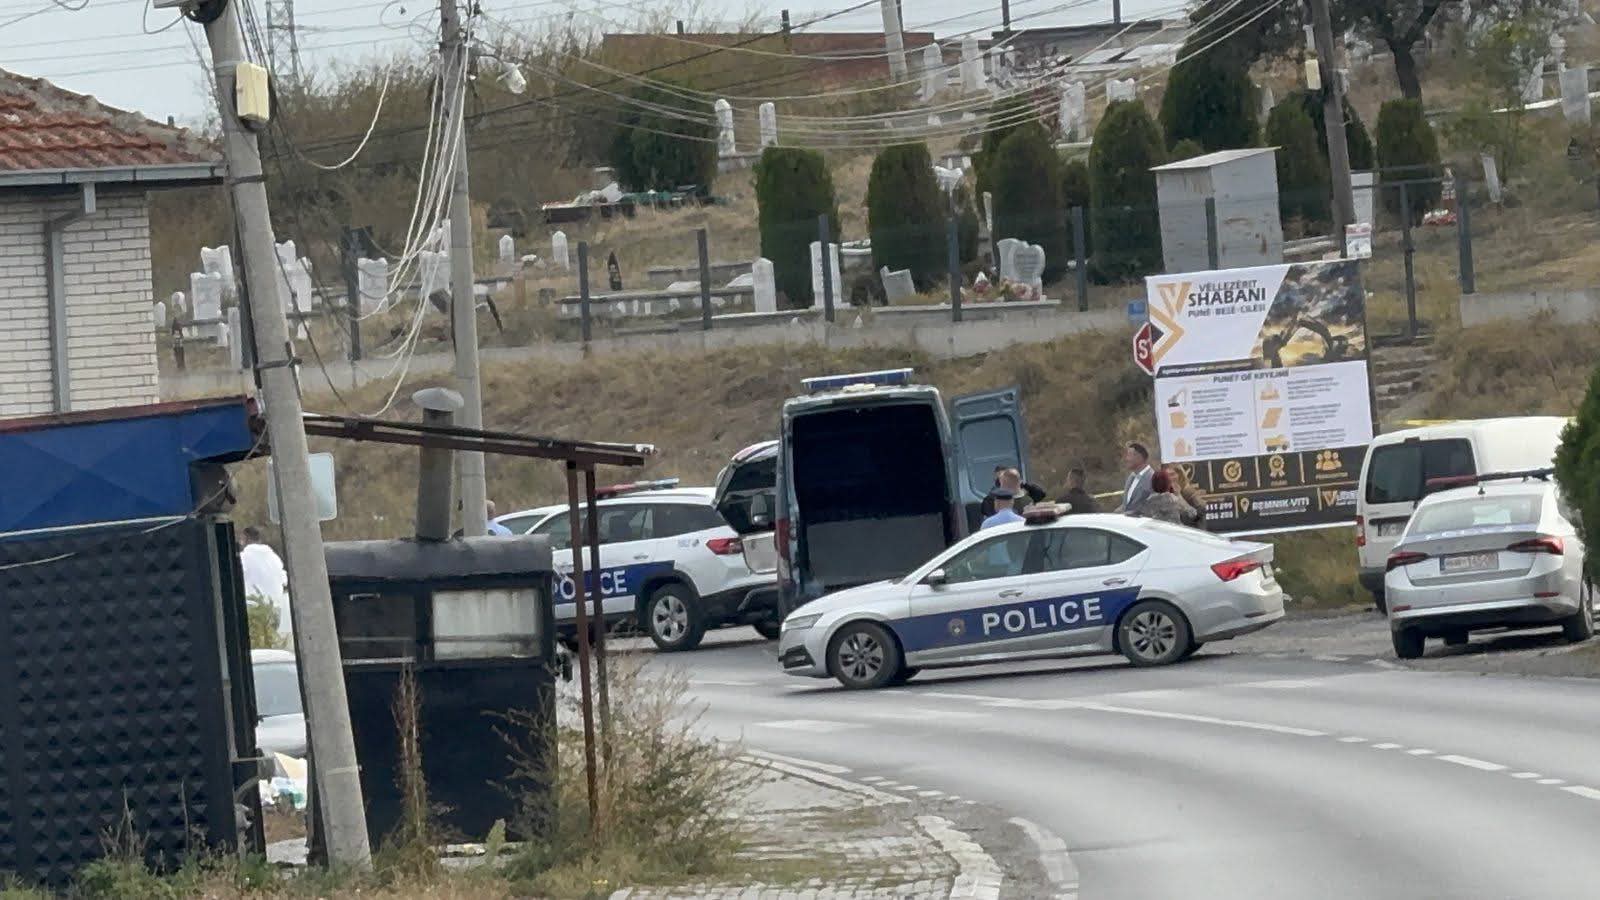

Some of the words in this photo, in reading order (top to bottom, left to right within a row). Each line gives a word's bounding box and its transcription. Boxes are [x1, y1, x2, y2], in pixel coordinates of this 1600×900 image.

[1188, 287, 1266, 307] SHABANI
[554, 569, 628, 600] OCE
[981, 597, 1104, 636] POLICE
